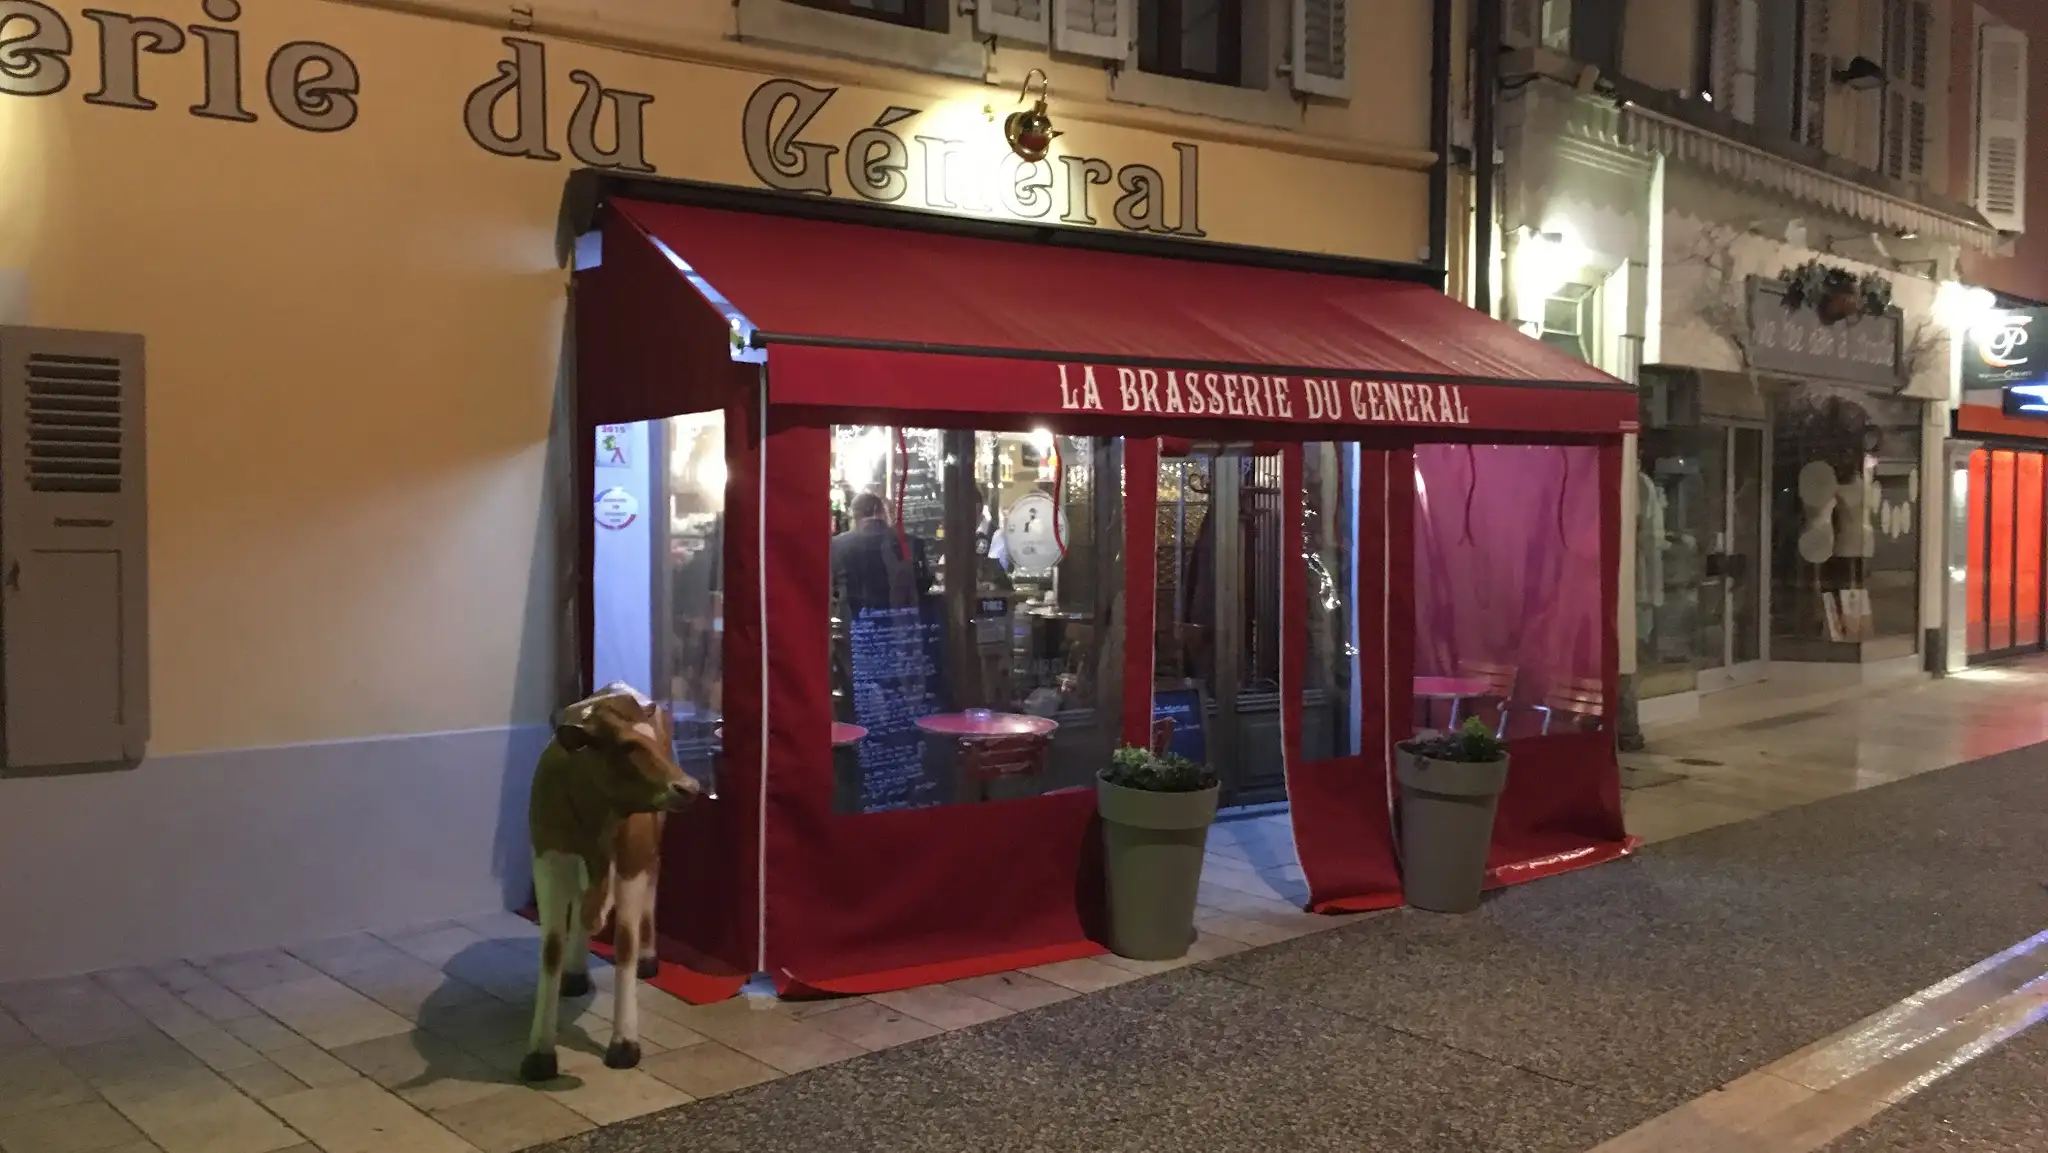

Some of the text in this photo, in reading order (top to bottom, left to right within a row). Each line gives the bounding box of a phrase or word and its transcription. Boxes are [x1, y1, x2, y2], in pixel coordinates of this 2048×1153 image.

[463, 36, 656, 173] du
[1058, 364, 1470, 425] LA BRASSERIE DU GENERAL
